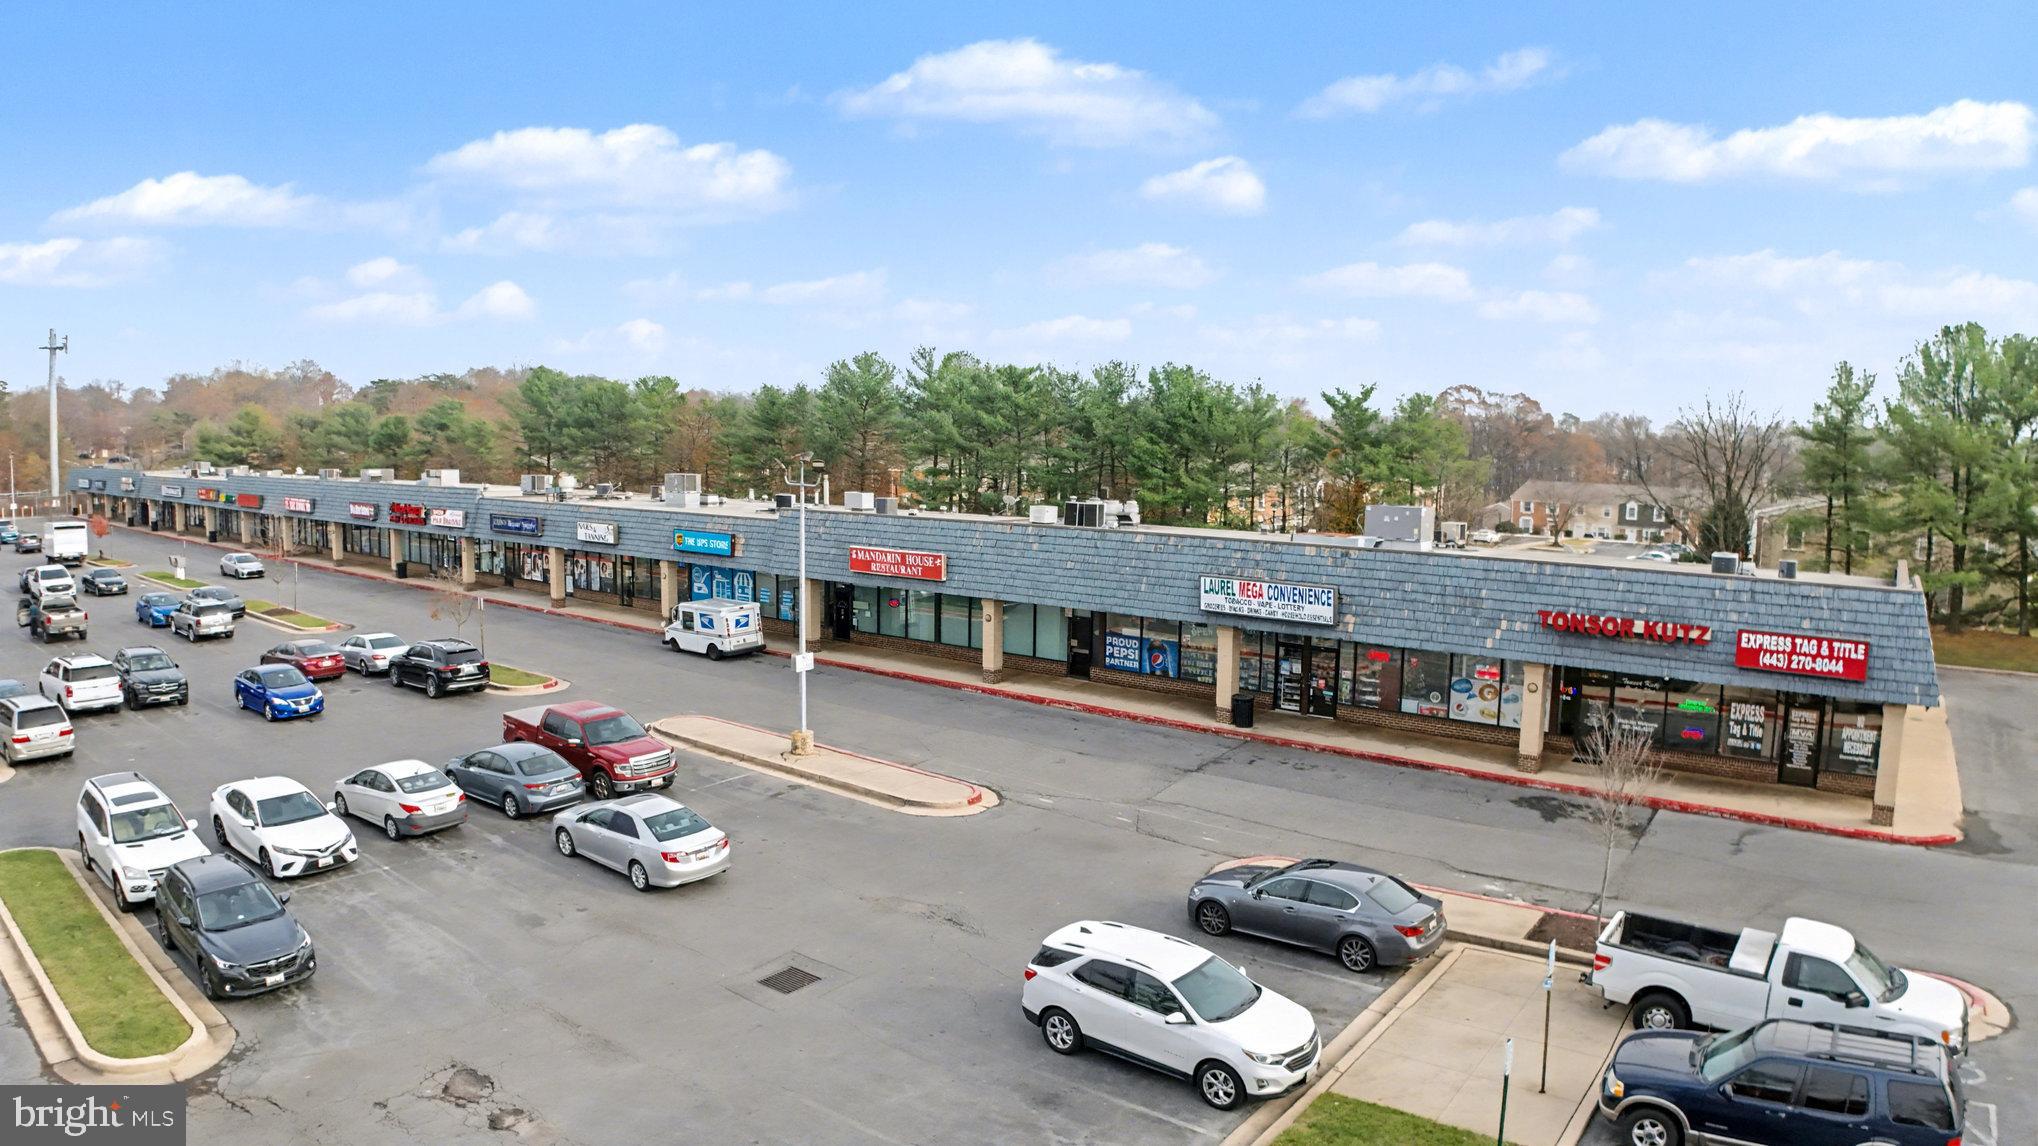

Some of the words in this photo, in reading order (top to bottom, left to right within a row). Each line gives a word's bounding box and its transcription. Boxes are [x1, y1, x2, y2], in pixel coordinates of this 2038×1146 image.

[684, 537, 695, 545] THE
[697, 538, 708, 548] UPS
[710, 540, 729, 550] STORE
[857, 550, 901, 563] MANDARIN
[906, 555, 934, 567] HOUSE
[870, 563, 922, 576] RESTAURANT
[1203, 578, 1236, 597] LAUREL
[1238, 581, 1264, 600] MEGA
[1267, 584, 1332, 608] CONVENIENCE
[1224, 596, 1252, 607] TOBACCO
[1257, 600, 1273, 609] VAPE
[1277, 602, 1305, 612] LOTTERY
[1537, 609, 1635, 638] TONSOR
[1643, 620, 1712, 646] KUTZ
[1106, 636, 1139, 649] PROUD
[1741, 633, 1793, 653] EXPRESS
[1794, 638, 1818, 656] TAG
[1820, 641, 1830, 657] &
[1833, 642, 1866, 661] TITLE
[1106, 646, 1139, 660] PEPSI
[1105, 657, 1139, 669] PARTNER
[1758, 654, 1789, 670] (443)
[1791, 656, 1844, 674] 270-8044
[1730, 702, 1765, 724] EXPRESS
[1729, 721, 1741, 738] Tag
[1749, 723, 1763, 738] Title
